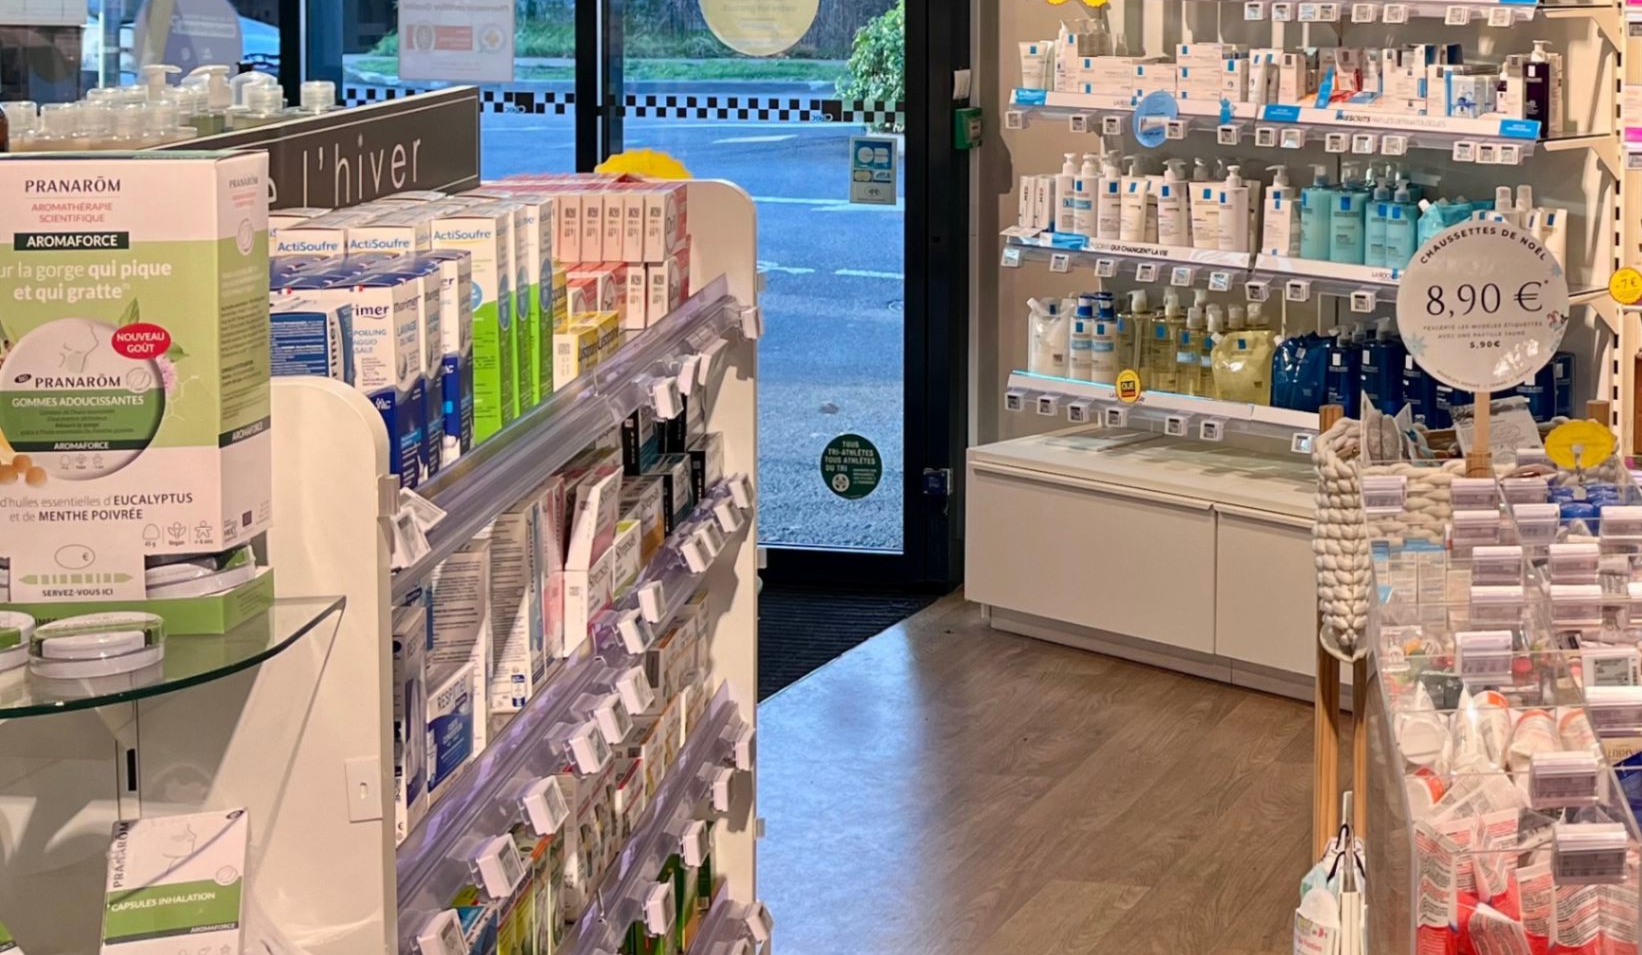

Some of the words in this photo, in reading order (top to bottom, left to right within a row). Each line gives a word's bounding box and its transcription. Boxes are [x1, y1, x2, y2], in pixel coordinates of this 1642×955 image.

[303, 133, 421, 208] l'hiver
[31, 202, 113, 212] AROMATHÉRAPIE
[39, 213, 105, 224] SCIENTIFIQUE
[434, 229, 491, 240] ActiSoufre
[26, 235, 118, 247] AROMAFORCE
[277, 241, 338, 252] ActiSoufre
[350, 238, 411, 249] ActiSoufre
[1420, 226, 1497, 264] CHAUSSETTES
[1501, 229, 1516, 240] DE
[1520, 237, 1546, 261] NOËL
[18, 262, 34, 277] la
[37, 266, 84, 281] gorge
[88, 260, 116, 279] qui
[121, 260, 172, 279] pique
[14, 285, 31, 301] et
[35, 283, 64, 302] qui
[67, 282, 122, 303] gratte
[1426, 283, 1501, 318] 8,90
[116, 332, 165, 342] NOUVEAU
[127, 342, 154, 353] GOÛT
[12, 398, 57, 407] GOMMES
[59, 396, 144, 407] ADOUCISSANTES
[53, 441, 109, 451] AROMAFORCE
[41, 494, 101, 508] essentielles
[9, 511, 20, 521] et
[22, 510, 35, 521] de
[38, 509, 89, 523] MENTHE
[91, 505, 144, 521] POIVRÉE
[42, 587, 100, 597] SERVEZ-VOUS
[101, 587, 114, 596] ICI
[111, 899, 156, 913] CAPSULES
[158, 891, 216, 907] INHALATION
